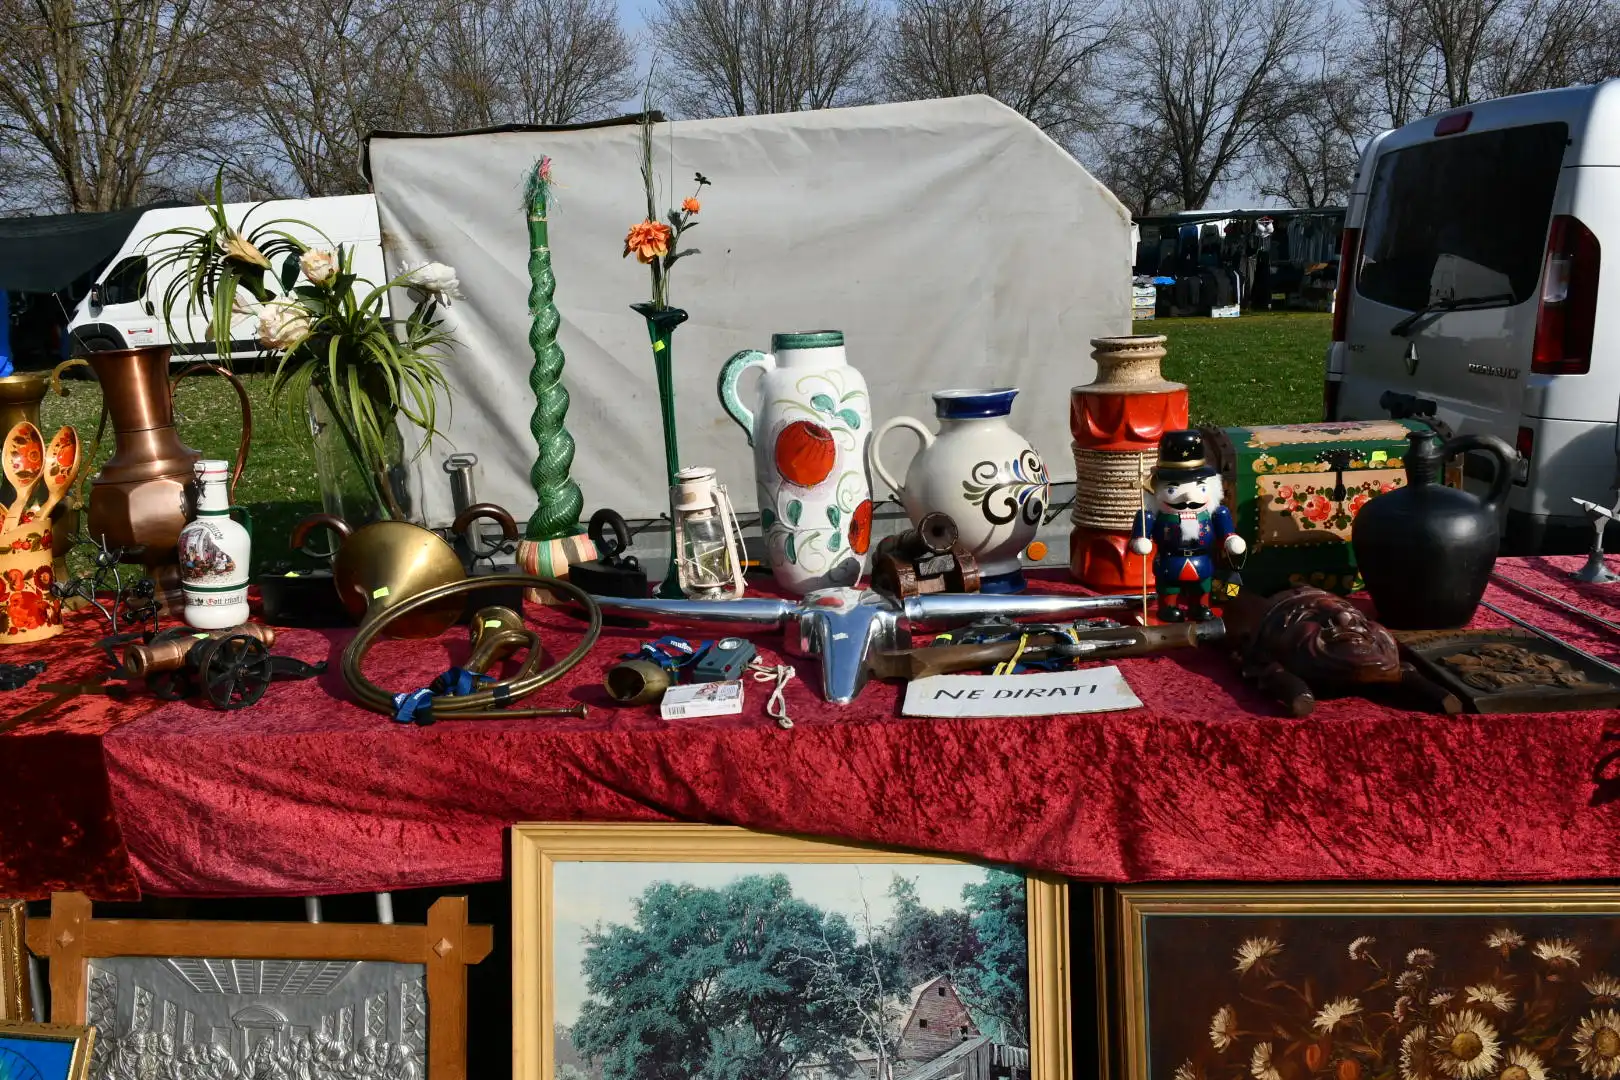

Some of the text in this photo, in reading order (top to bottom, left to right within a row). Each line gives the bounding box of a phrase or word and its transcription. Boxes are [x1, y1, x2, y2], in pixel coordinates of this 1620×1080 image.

[1468, 362, 1521, 379] RENAULT
[933, 684, 1098, 700] NE DIRATI
